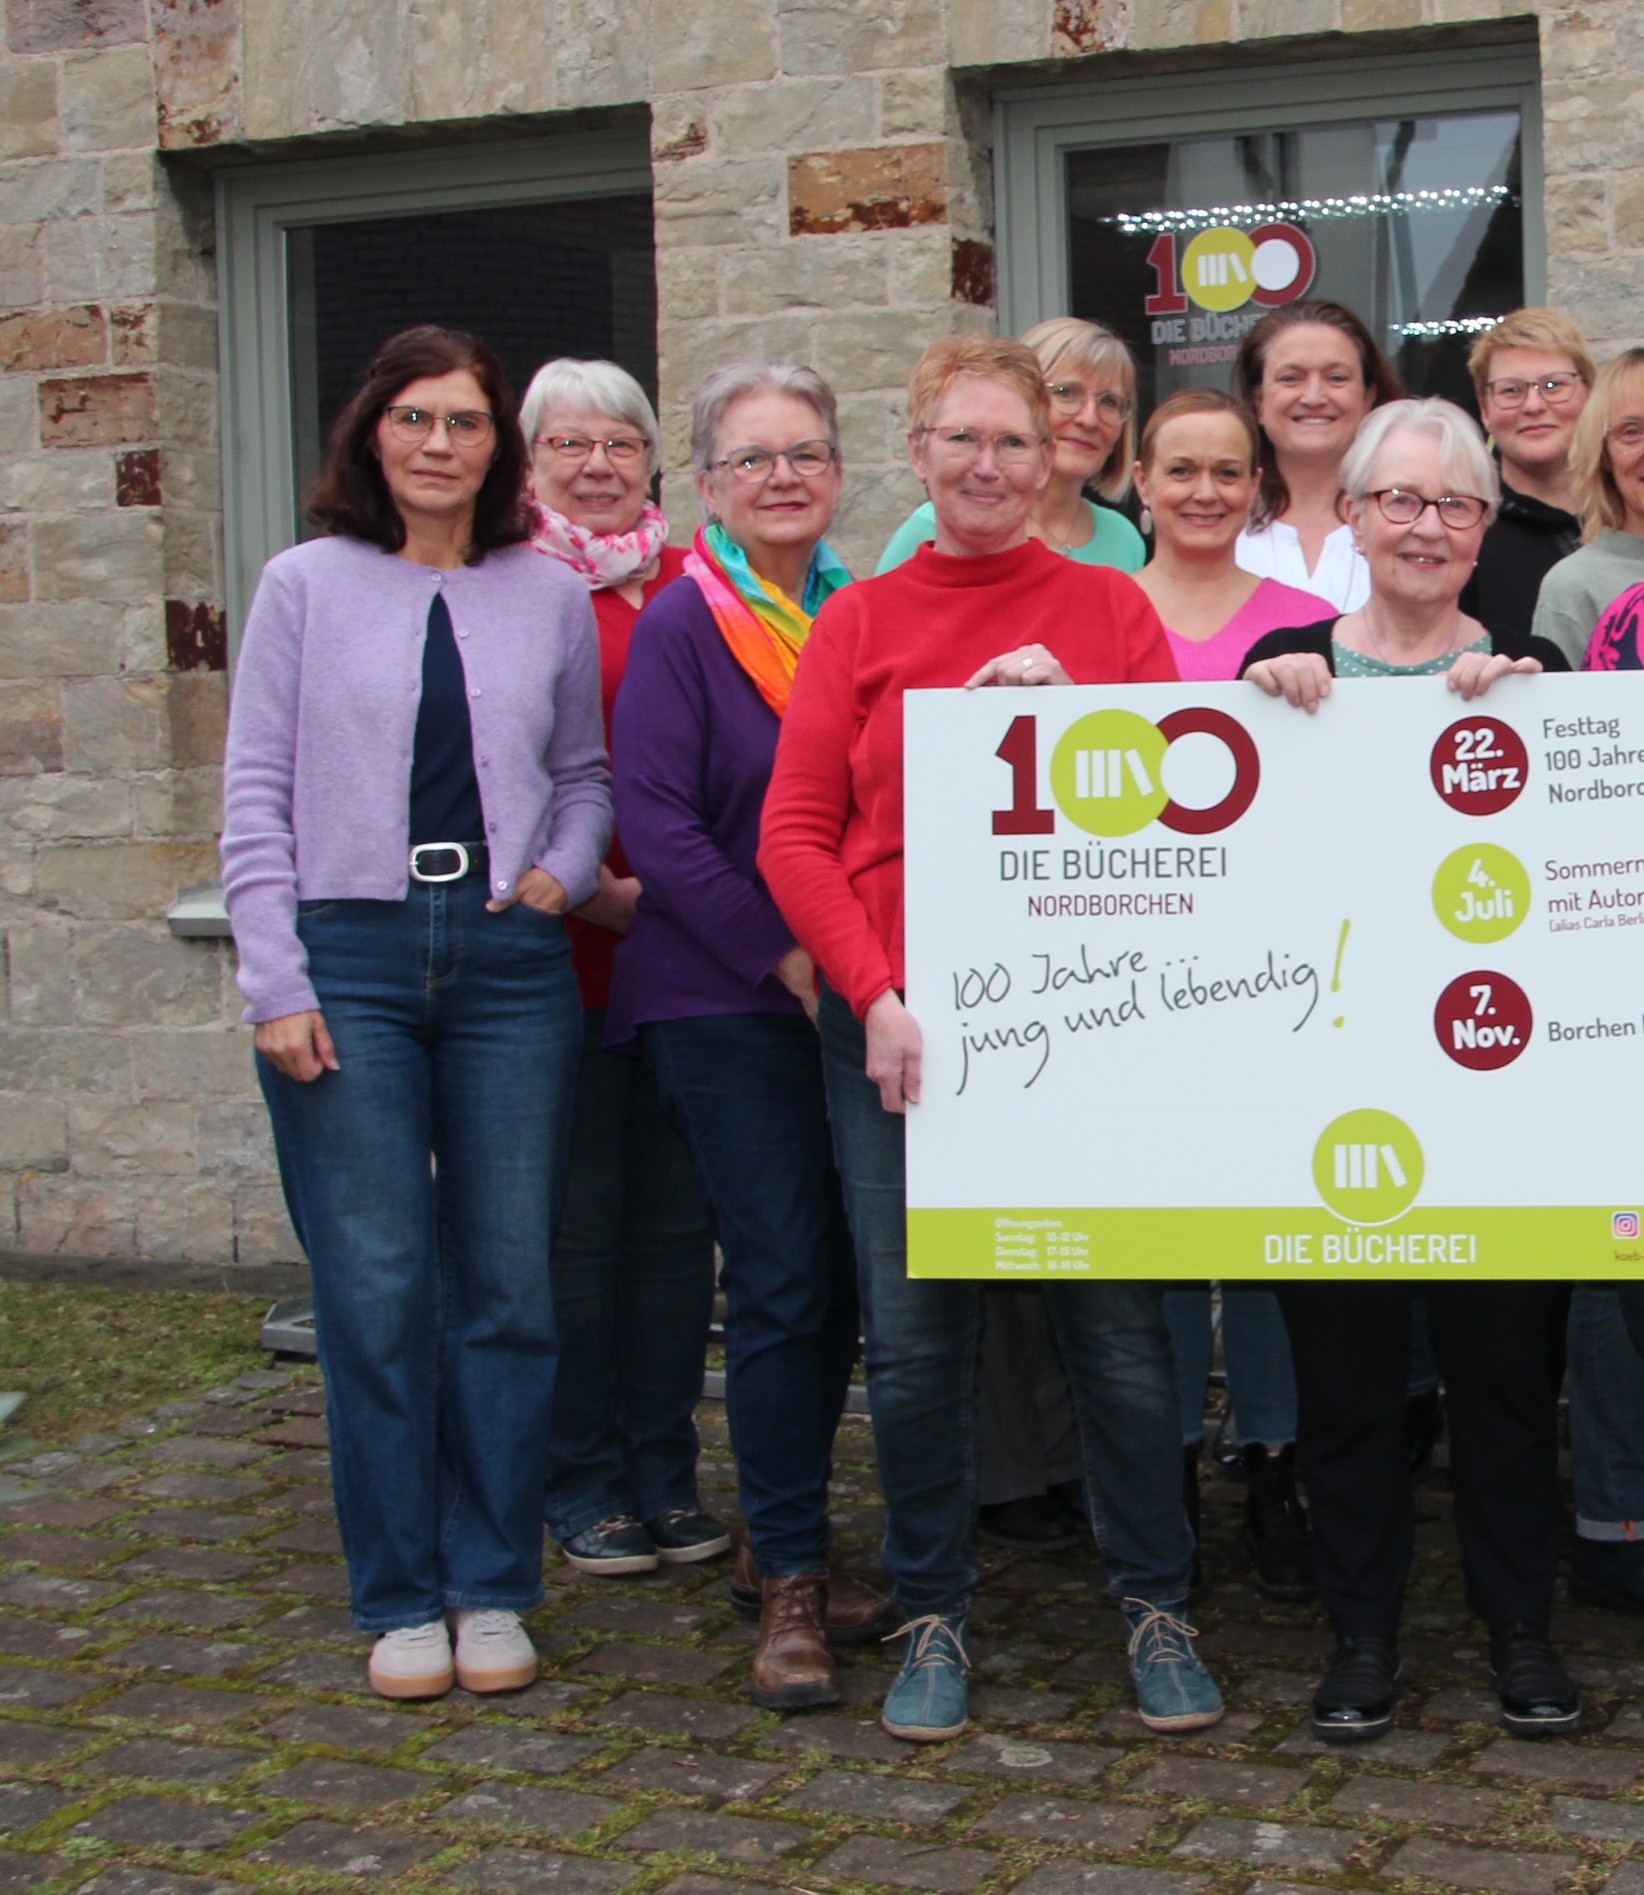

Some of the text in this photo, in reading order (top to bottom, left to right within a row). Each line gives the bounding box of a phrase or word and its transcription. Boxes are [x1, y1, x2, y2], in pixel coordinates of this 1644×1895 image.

[1151, 312, 1269, 345] DIE BÜCH
[1543, 716, 1620, 740] Festtag
[1454, 728, 1504, 761] 22.
[1544, 749, 1582, 771] 100
[992, 707, 1260, 836] 100
[1442, 764, 1521, 794] März
[1000, 841, 1227, 880] DIE BÜCHEREI
[1467, 858, 1496, 887] 4.
[1028, 893, 1194, 917] NORDBORCHEN
[1454, 891, 1514, 922] Juli
[1548, 890, 1583, 913] mit
[1549, 918, 1582, 932] (alias
[1584, 914, 1615, 930] Carla
[953, 962, 1011, 1010] 100
[1032, 944, 1148, 994] Jahre
[1469, 984, 1496, 1016] 7.
[956, 1019, 1051, 1096] jung
[1064, 980, 1146, 1034] und
[1452, 1019, 1521, 1050] Nov.
[1548, 1015, 1636, 1042] Borchen
[1264, 1227, 1477, 1264] DIE BÜCHEREI
